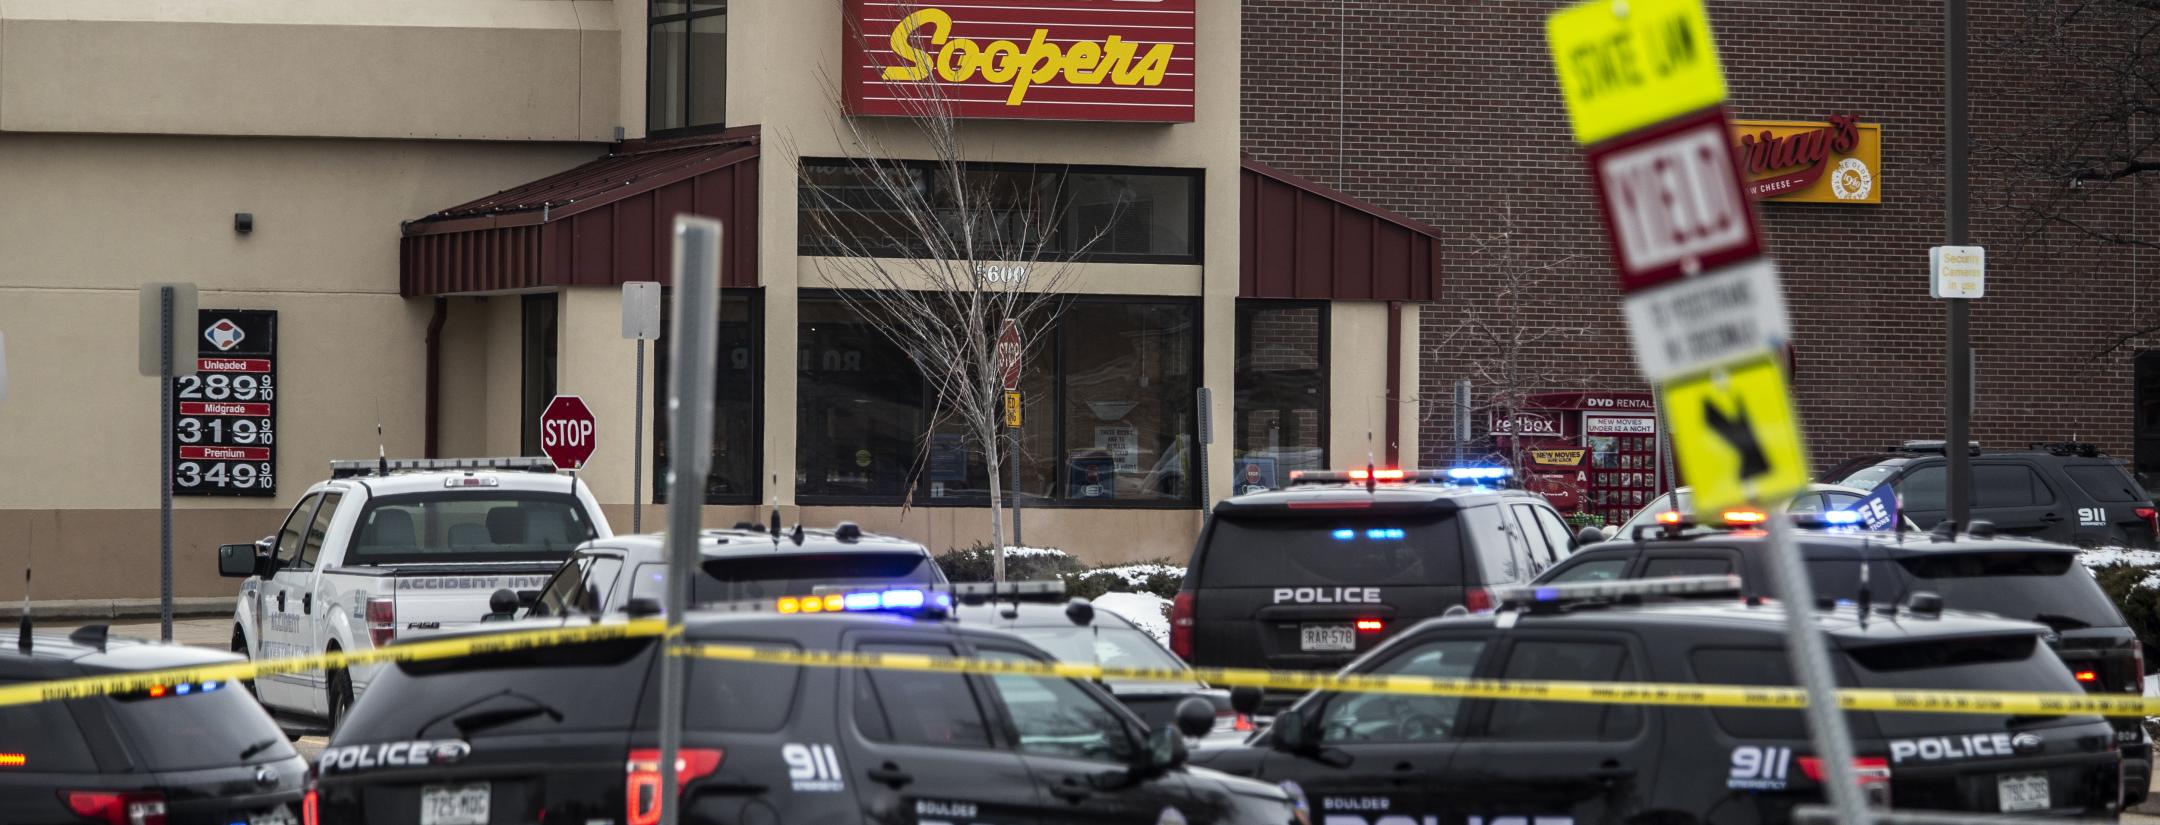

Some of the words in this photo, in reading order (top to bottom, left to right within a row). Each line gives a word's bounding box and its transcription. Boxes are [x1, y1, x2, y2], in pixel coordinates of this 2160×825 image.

[882, 8, 1174, 106] Soopers
[1740, 114, 1860, 174] rray's
[1760, 179, 1792, 194] CHEESE
[204, 360, 247, 371] Unleaded
[999, 342, 1020, 368] STOP
[178, 374, 258, 400] 289
[204, 403, 246, 415] Midgrade
[1587, 398, 1614, 407] DVD
[177, 417, 257, 444] 319
[545, 419, 593, 447] STOP
[204, 448, 246, 459] Premium
[1554, 451, 1581, 459] MOVIES
[176, 461, 257, 488] 349
[2078, 507, 2106, 522] 911
[399, 577, 499, 590] ACCIDENT
[1273, 587, 1382, 604] POLICE
[319, 740, 432, 775] POLICE
[1889, 733, 2014, 763] POLICE
[782, 742, 842, 781] 911
[1730, 746, 1791, 780] 911
[915, 800, 978, 818] BOULDER
[1324, 797, 1391, 810] BOULDER
